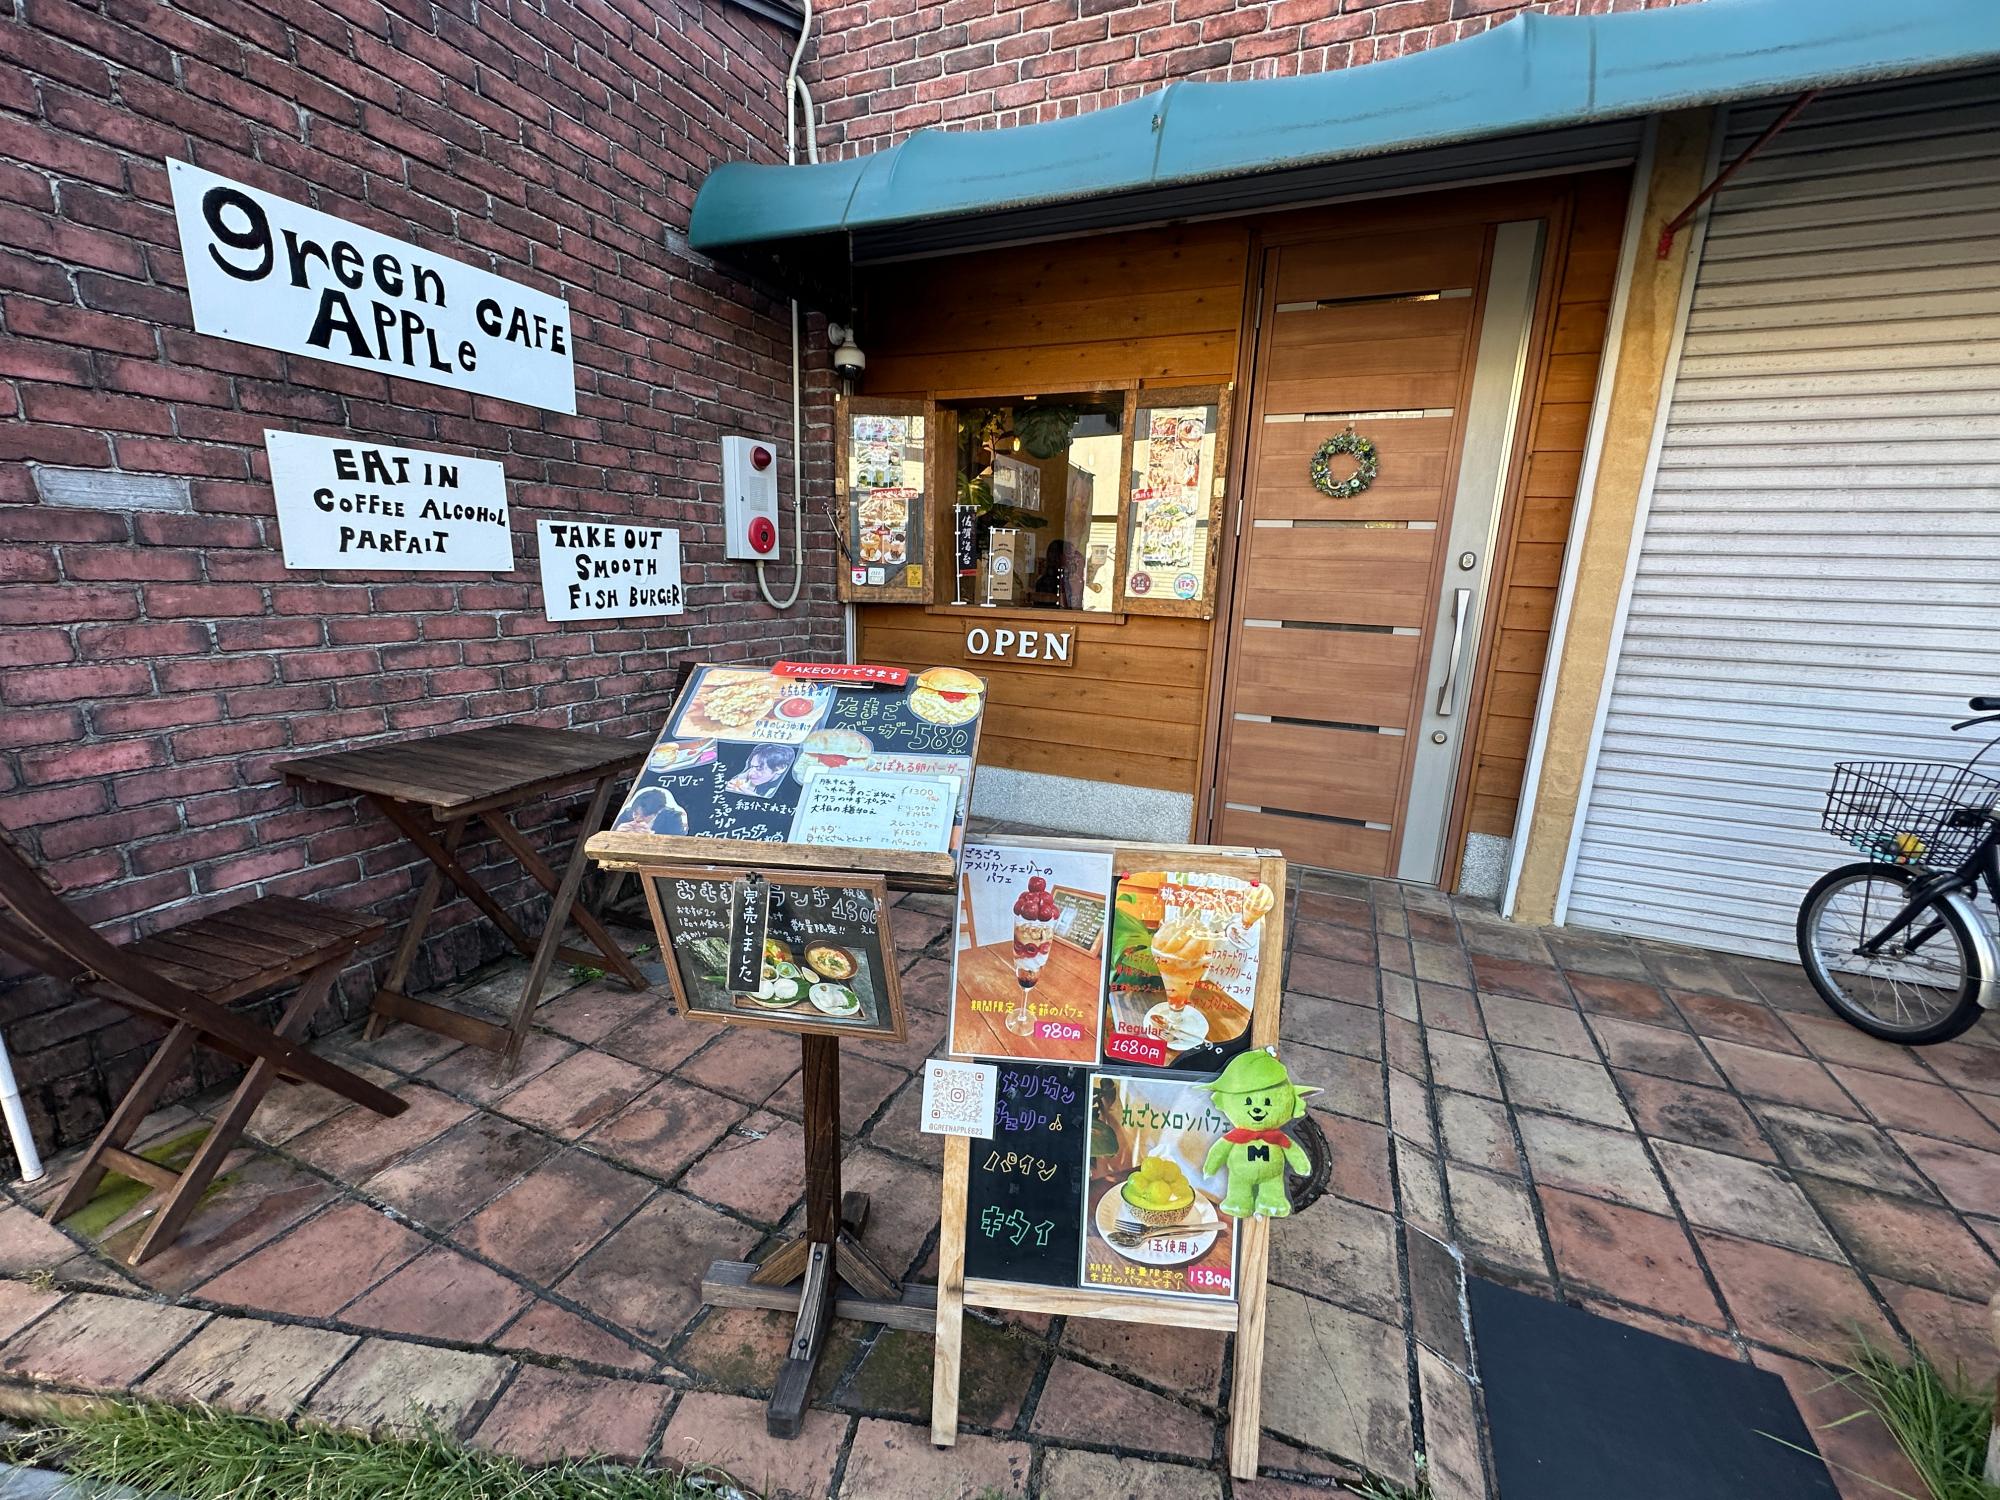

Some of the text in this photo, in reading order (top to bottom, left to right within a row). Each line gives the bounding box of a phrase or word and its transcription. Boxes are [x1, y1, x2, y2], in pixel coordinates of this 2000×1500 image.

[202, 187, 447, 307] green
[306, 288, 476, 374] APPLe
[476, 298, 566, 355] CAFE
[333, 449, 458, 488] EAT IN
[313, 488, 506, 527] COFFEE ALCOHOL
[339, 527, 449, 553] PARFAIT
[550, 525, 663, 550] TAKE OUT
[576, 554, 657, 581] SMOOTH
[569, 584, 680, 610] FISH BURGER
[967, 628, 1070, 661] OPEN
[835, 697, 907, 720] たまご
[833, 720, 968, 750] バーガー 580
[658, 775, 704, 787] TVで
[965, 848, 1001, 860] ごろごろ
[965, 861, 1053, 875] アメリカンチェリーの
[986, 872, 1012, 884] パフェ
[831, 898, 878, 924] 1300
[738, 886, 758, 982] 完売しました
[1212, 951, 1259, 963] カスタードクリーム
[1209, 964, 1252, 980] ホイップクリーム
[971, 1000, 1084, 1018] 期間限定 季節のパフェ
[1042, 1023, 1081, 1039] 980円
[1118, 1021, 1163, 1037] Regular
[1112, 1040, 1160, 1059] 1680円
[999, 1072, 1075, 1104] メリカン
[1122, 1103, 1231, 1134] 丸ごとメロンパフェ
[983, 1151, 1057, 1181] パイン
[1248, 1145, 1269, 1161] M
[1190, 1270, 1231, 1289] 1580円
